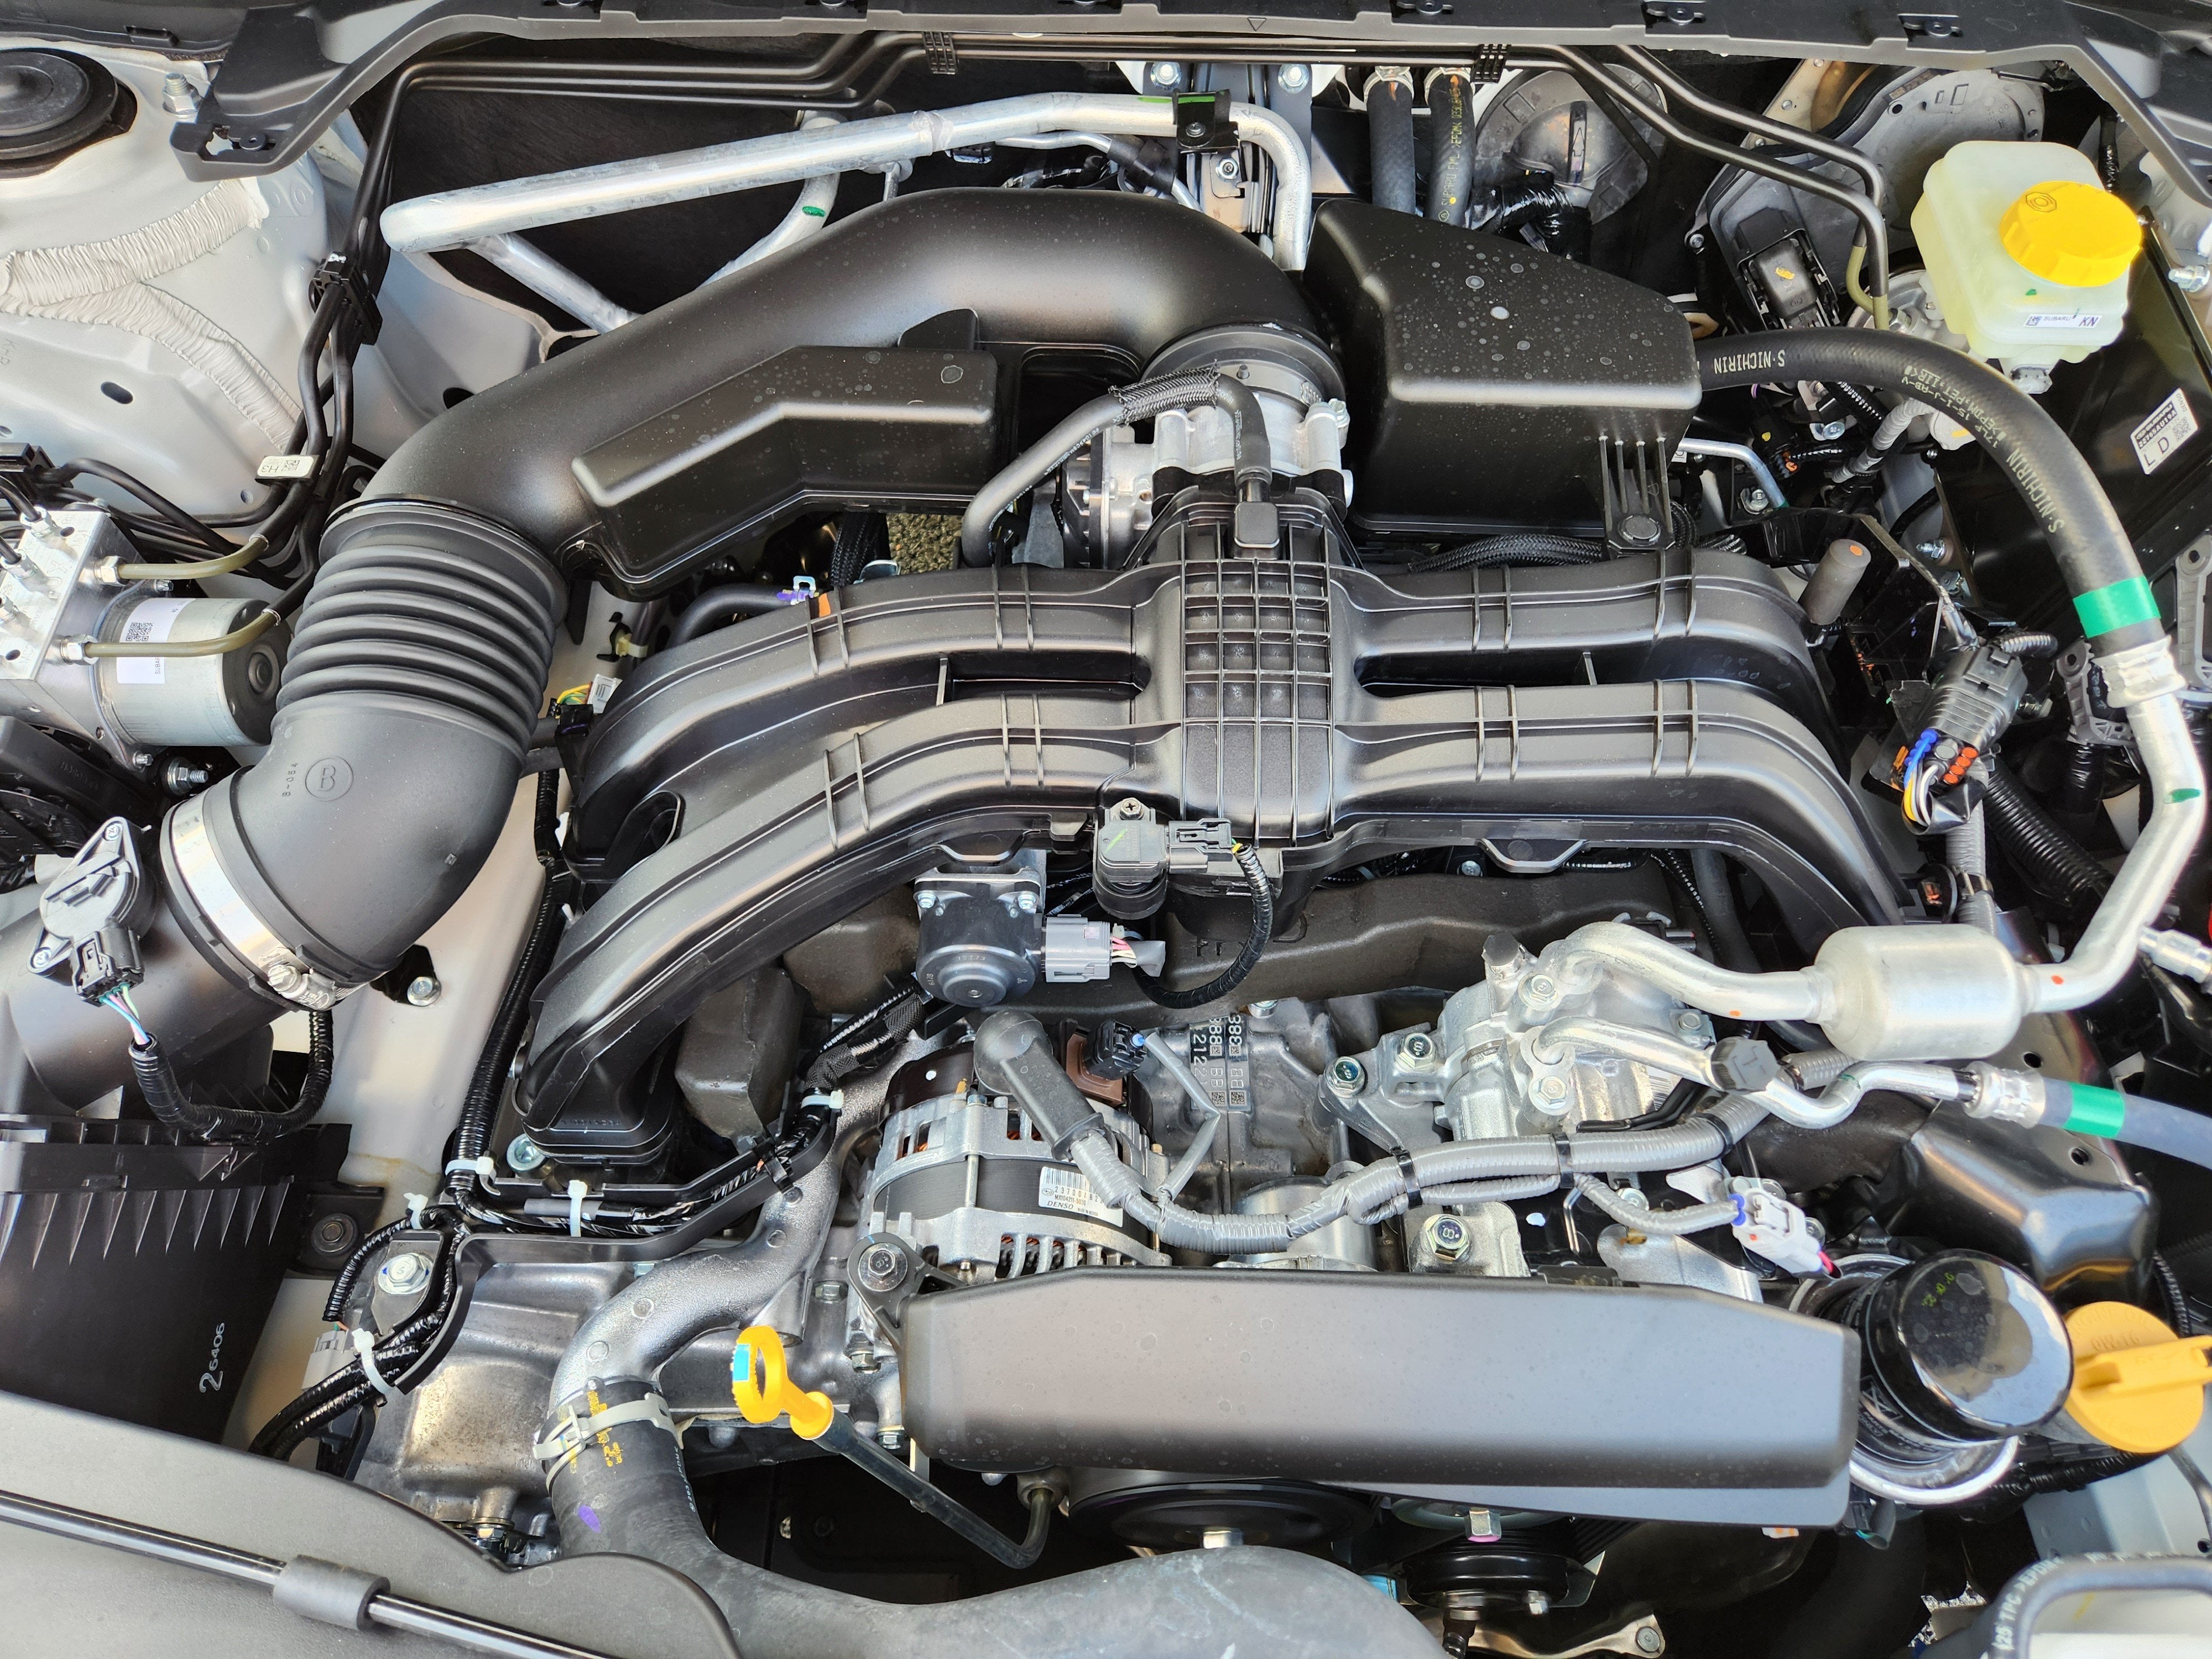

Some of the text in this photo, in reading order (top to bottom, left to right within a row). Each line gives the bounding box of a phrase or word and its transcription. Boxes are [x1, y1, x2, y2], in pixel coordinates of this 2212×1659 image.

[2078, 316, 2099, 327] KN
[2176, 393, 2188, 413] DENSO
[2143, 436, 2169, 467] L D
[261, 465, 279, 473] H3
[317, 765, 336, 792] B
[1209, 1067, 1224, 1088] BB
[1047, 1200, 1074, 1209] DENSO
